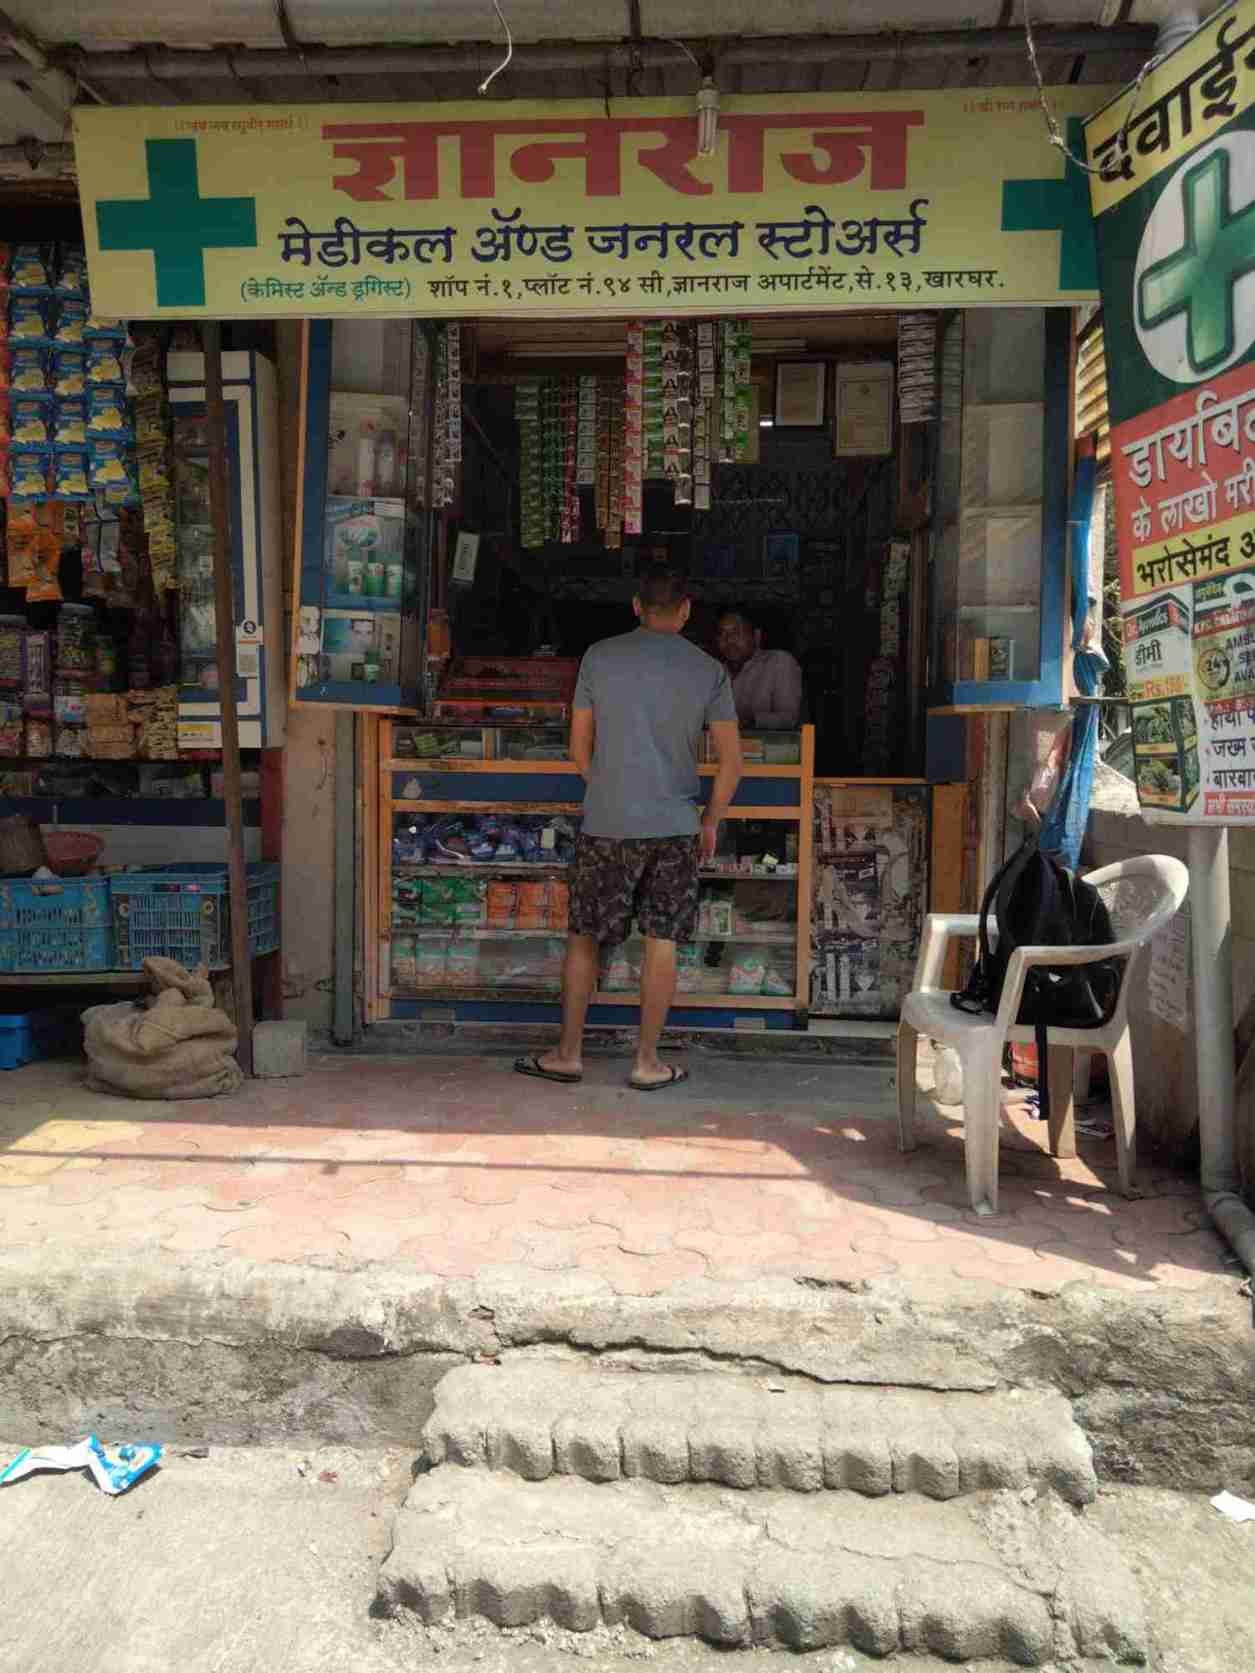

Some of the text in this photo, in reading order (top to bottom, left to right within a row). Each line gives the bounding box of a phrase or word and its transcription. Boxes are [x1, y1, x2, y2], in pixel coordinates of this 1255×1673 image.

[321, 110, 925, 202] ज्ञानराज
[278, 217, 457, 266] मेडीकल
[585, 221, 744, 261] जनरल
[756, 198, 930, 260] स्टोअर्स
[427, 275, 468, 299] शॉप
